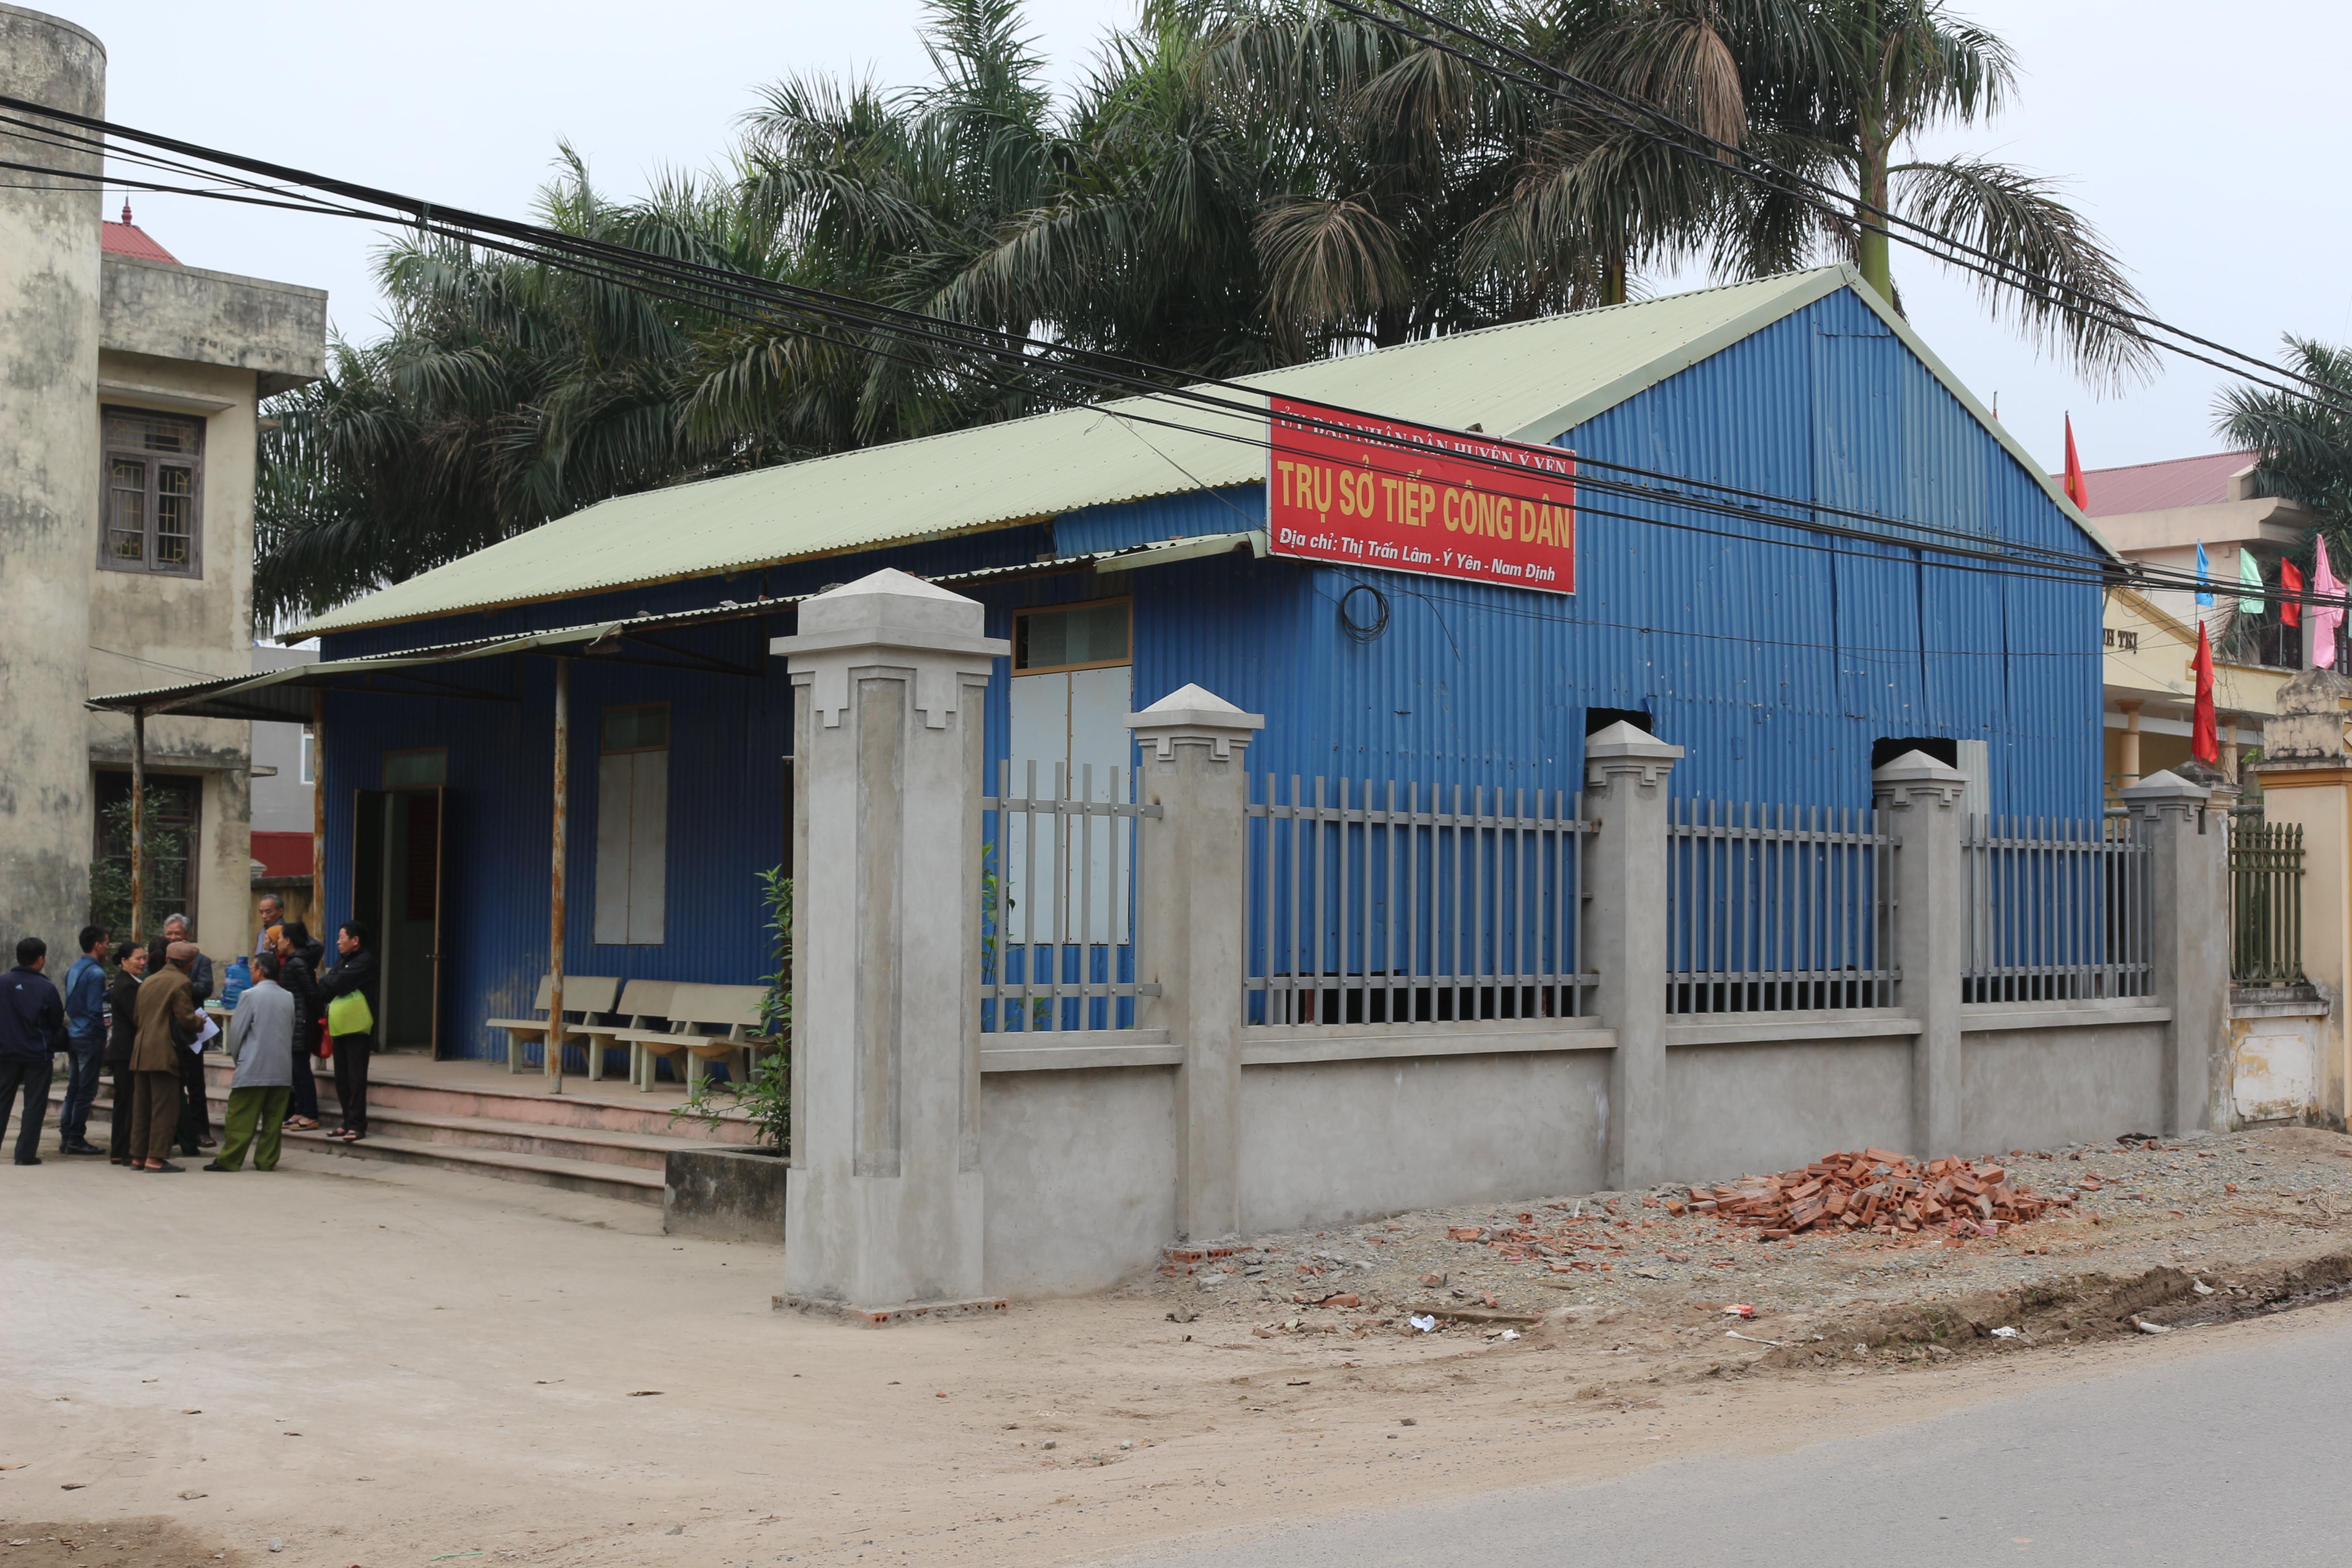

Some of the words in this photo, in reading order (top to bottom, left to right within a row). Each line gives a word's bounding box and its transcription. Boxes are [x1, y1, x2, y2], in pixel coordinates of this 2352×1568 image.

[1312, 416, 1351, 440] BAN
[1356, 425, 1407, 450] NHÂN
[1412, 433, 1448, 457] DÂN
[1518, 451, 1530, 467] Ý
[1533, 455, 1566, 474] YÊN
[1277, 460, 1332, 523] TRỤ
[1339, 454, 1375, 519] SỞ
[1382, 469, 1436, 527] TIẾP
[1443, 479, 1513, 540] CÔNG
[1520, 493, 1570, 549] DÂN
[1279, 527, 1307, 549] Địa
[1309, 532, 1338, 551] chỉ:
[1341, 537, 1364, 559] Thị
[1367, 541, 1398, 559] Trấn
[1402, 546, 1432, 564] Lâm
[1443, 548, 1453, 567] Ý
[1456, 553, 1481, 571] Yên
[1491, 558, 1522, 577] Nam
[1525, 563, 1556, 583] Định
[2117, 630, 2138, 654] TRỊ
